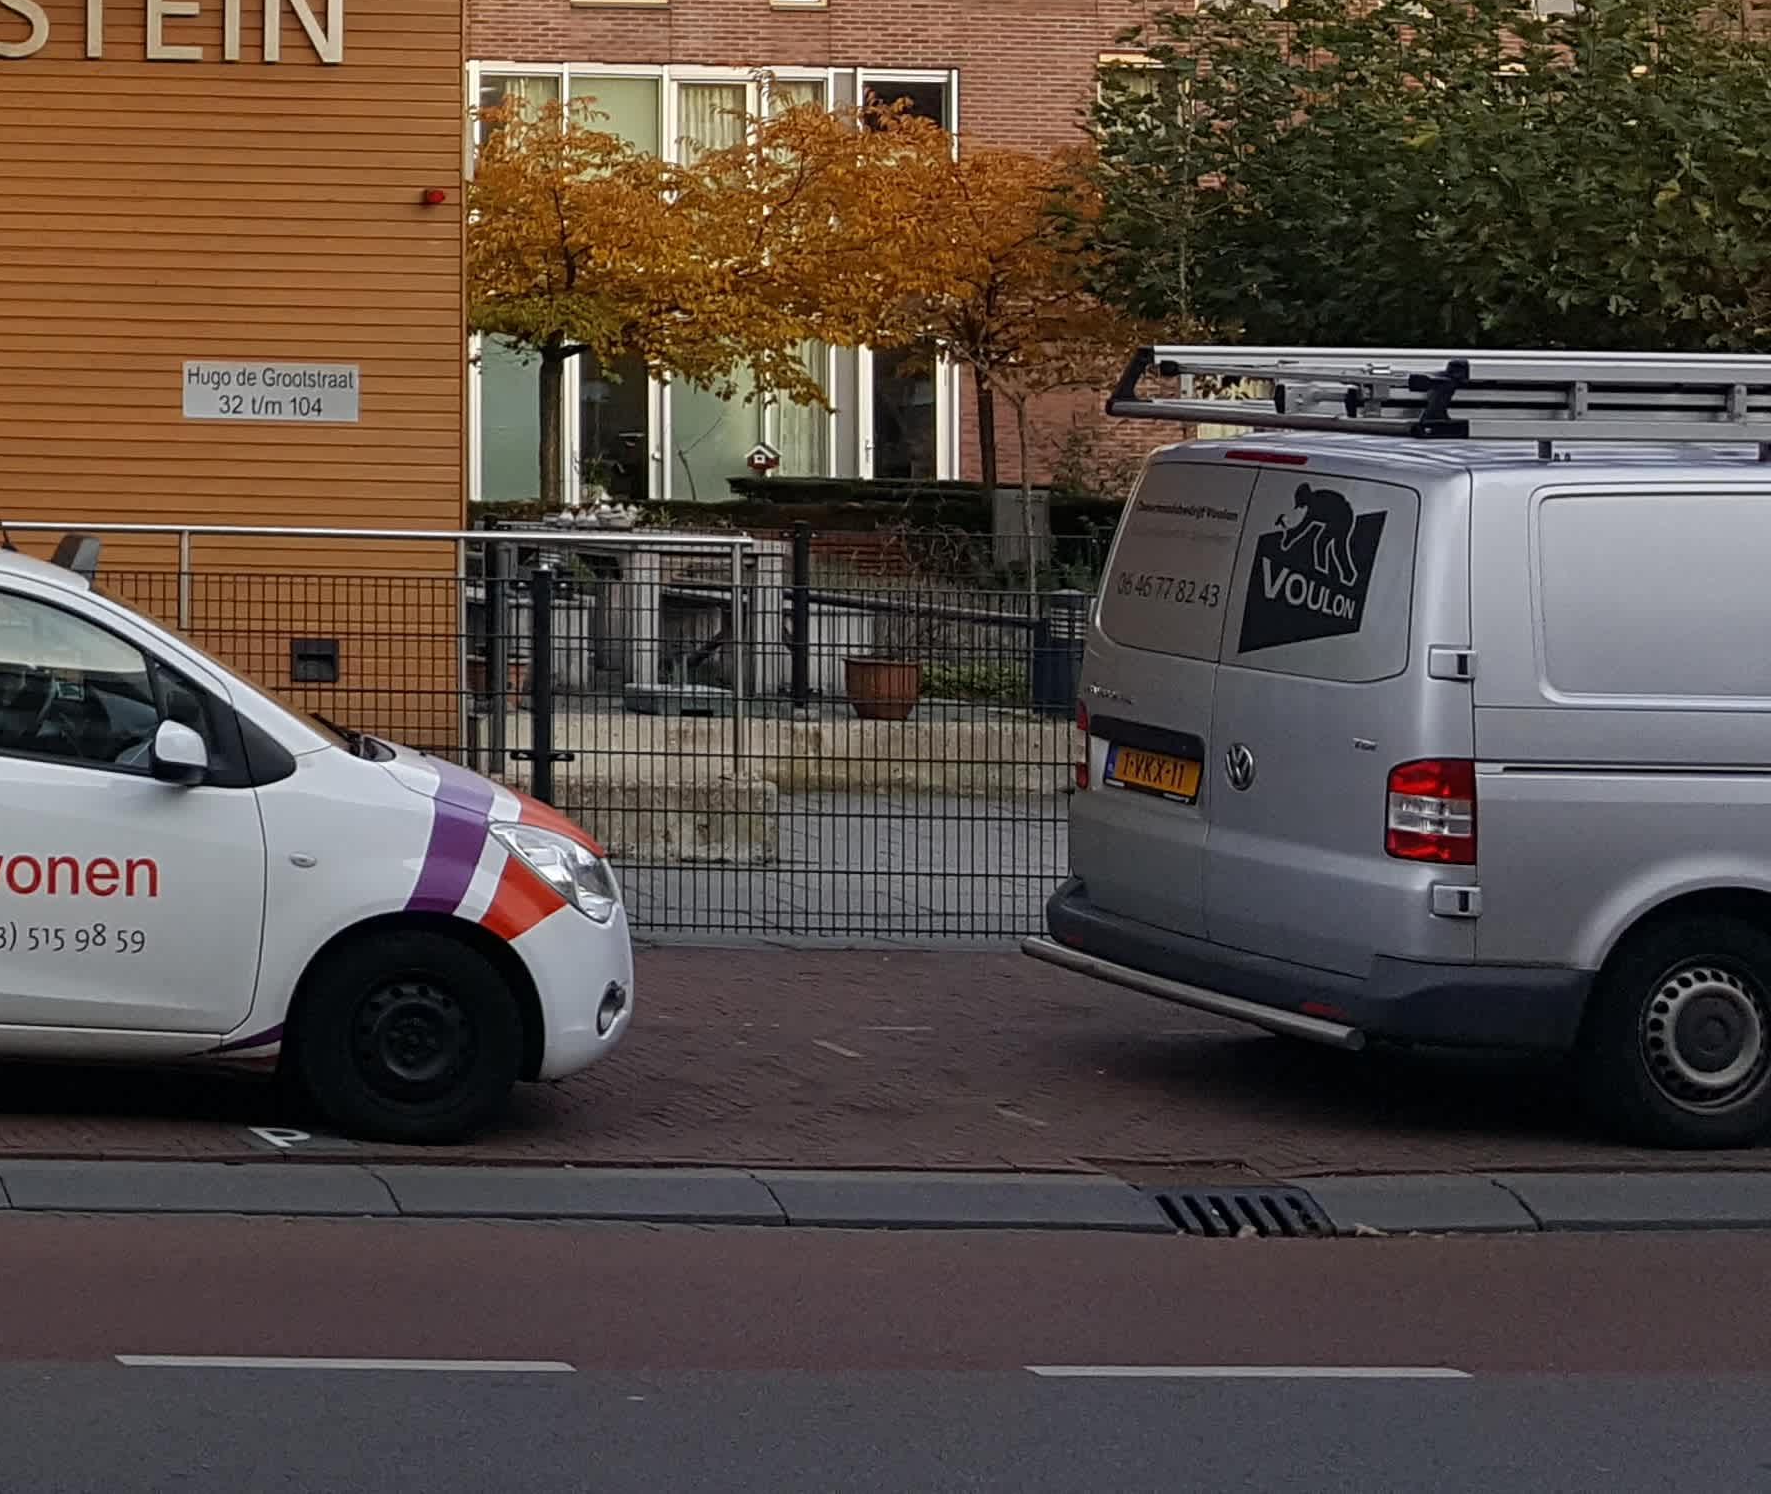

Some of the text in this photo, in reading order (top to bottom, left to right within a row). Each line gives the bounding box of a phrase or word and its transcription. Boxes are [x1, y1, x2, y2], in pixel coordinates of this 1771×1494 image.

[187, 367, 354, 390] Hugo de Grootstraat
[218, 394, 323, 417] 32 t/m 104
[1155, 575, 1175, 601] 77
[1175, 578, 1196, 604] 82
[1197, 583, 1221, 608] 43
[1261, 557, 1356, 620] VOULON
[27, 928, 65, 952] 515
[75, 923, 107, 953] 98
[115, 928, 146, 954] 59
